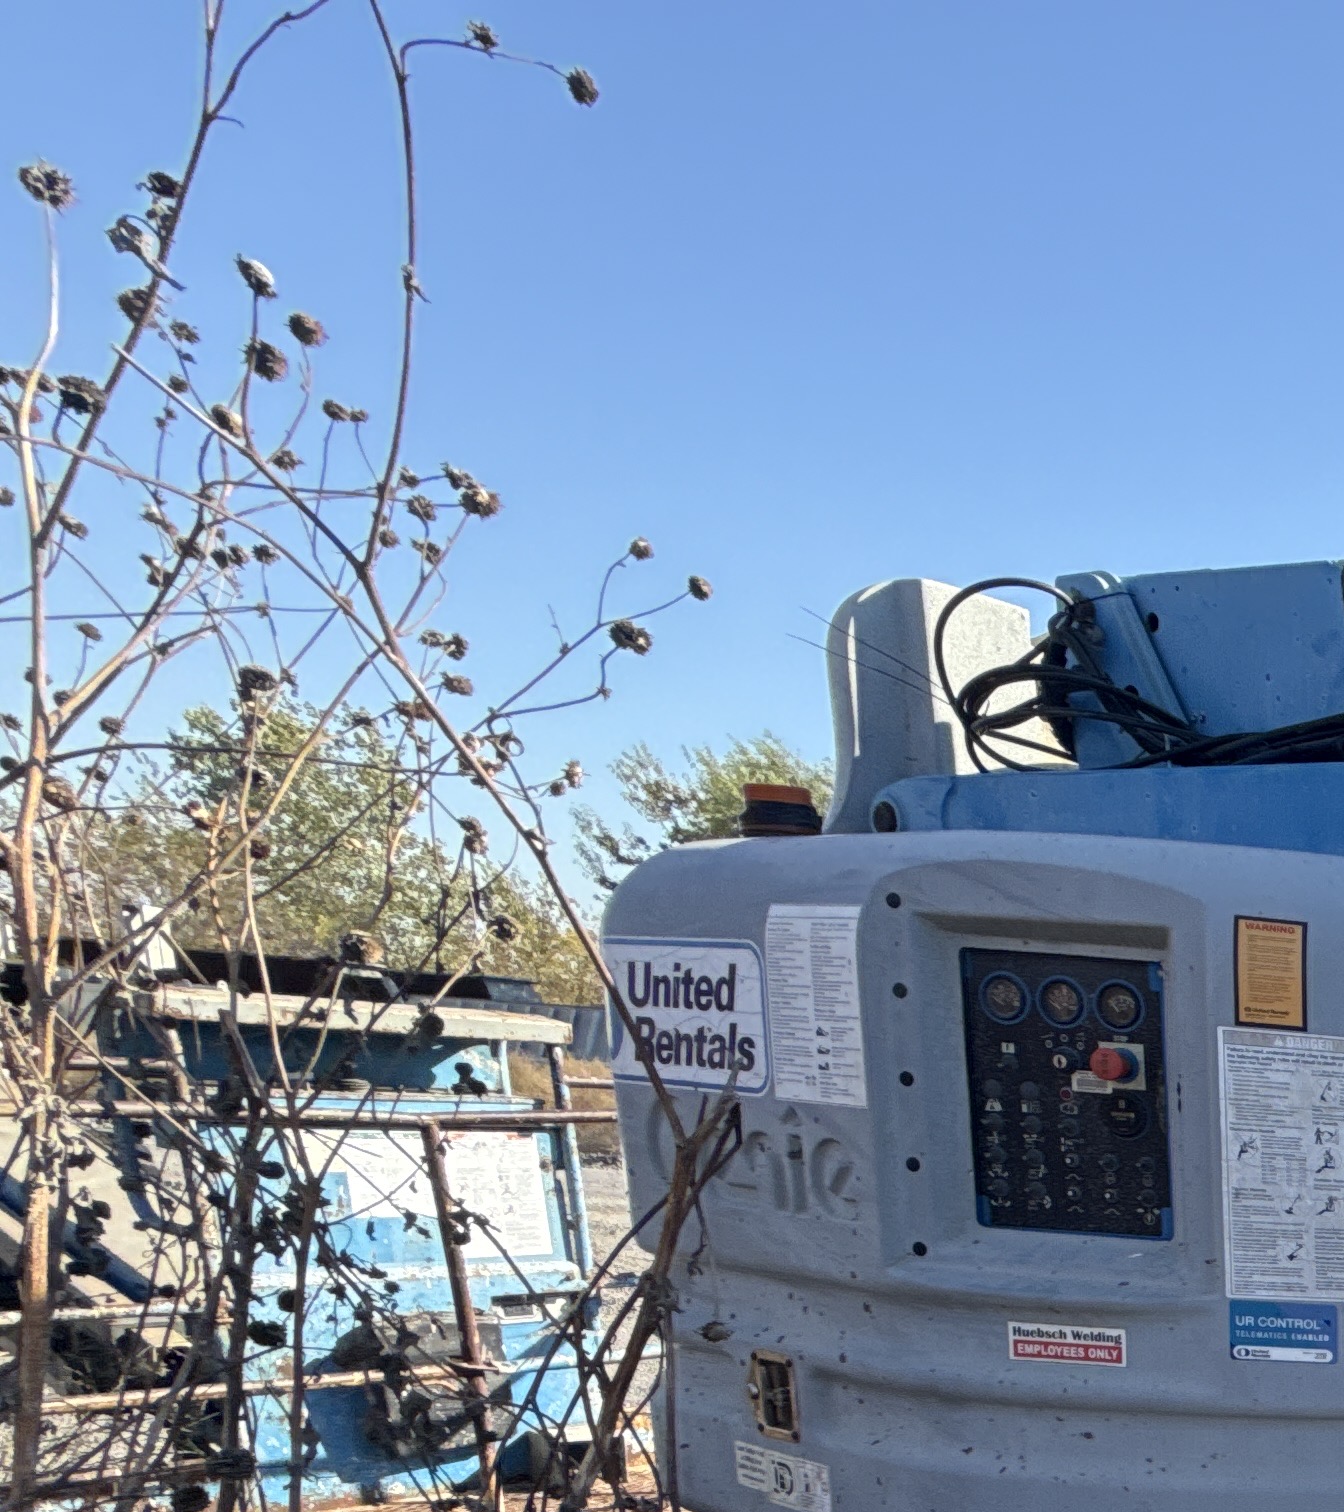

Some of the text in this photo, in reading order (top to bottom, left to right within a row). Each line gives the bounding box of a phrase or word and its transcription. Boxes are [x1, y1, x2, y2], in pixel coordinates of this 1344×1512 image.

[1245, 922, 1296, 934] WARNING
[628, 961, 737, 1012] United
[634, 1015, 756, 1072] Rentals
[1286, 1036, 1333, 1051] DANGER
[1235, 1315, 1321, 1330] UR CONTROL
[1012, 1325, 1122, 1345] Huebsch Welding
[1235, 1330, 1330, 1342] TELEMATICS ENABLED
[1017, 1343, 1119, 1360] EMPLOYEES ONLY
